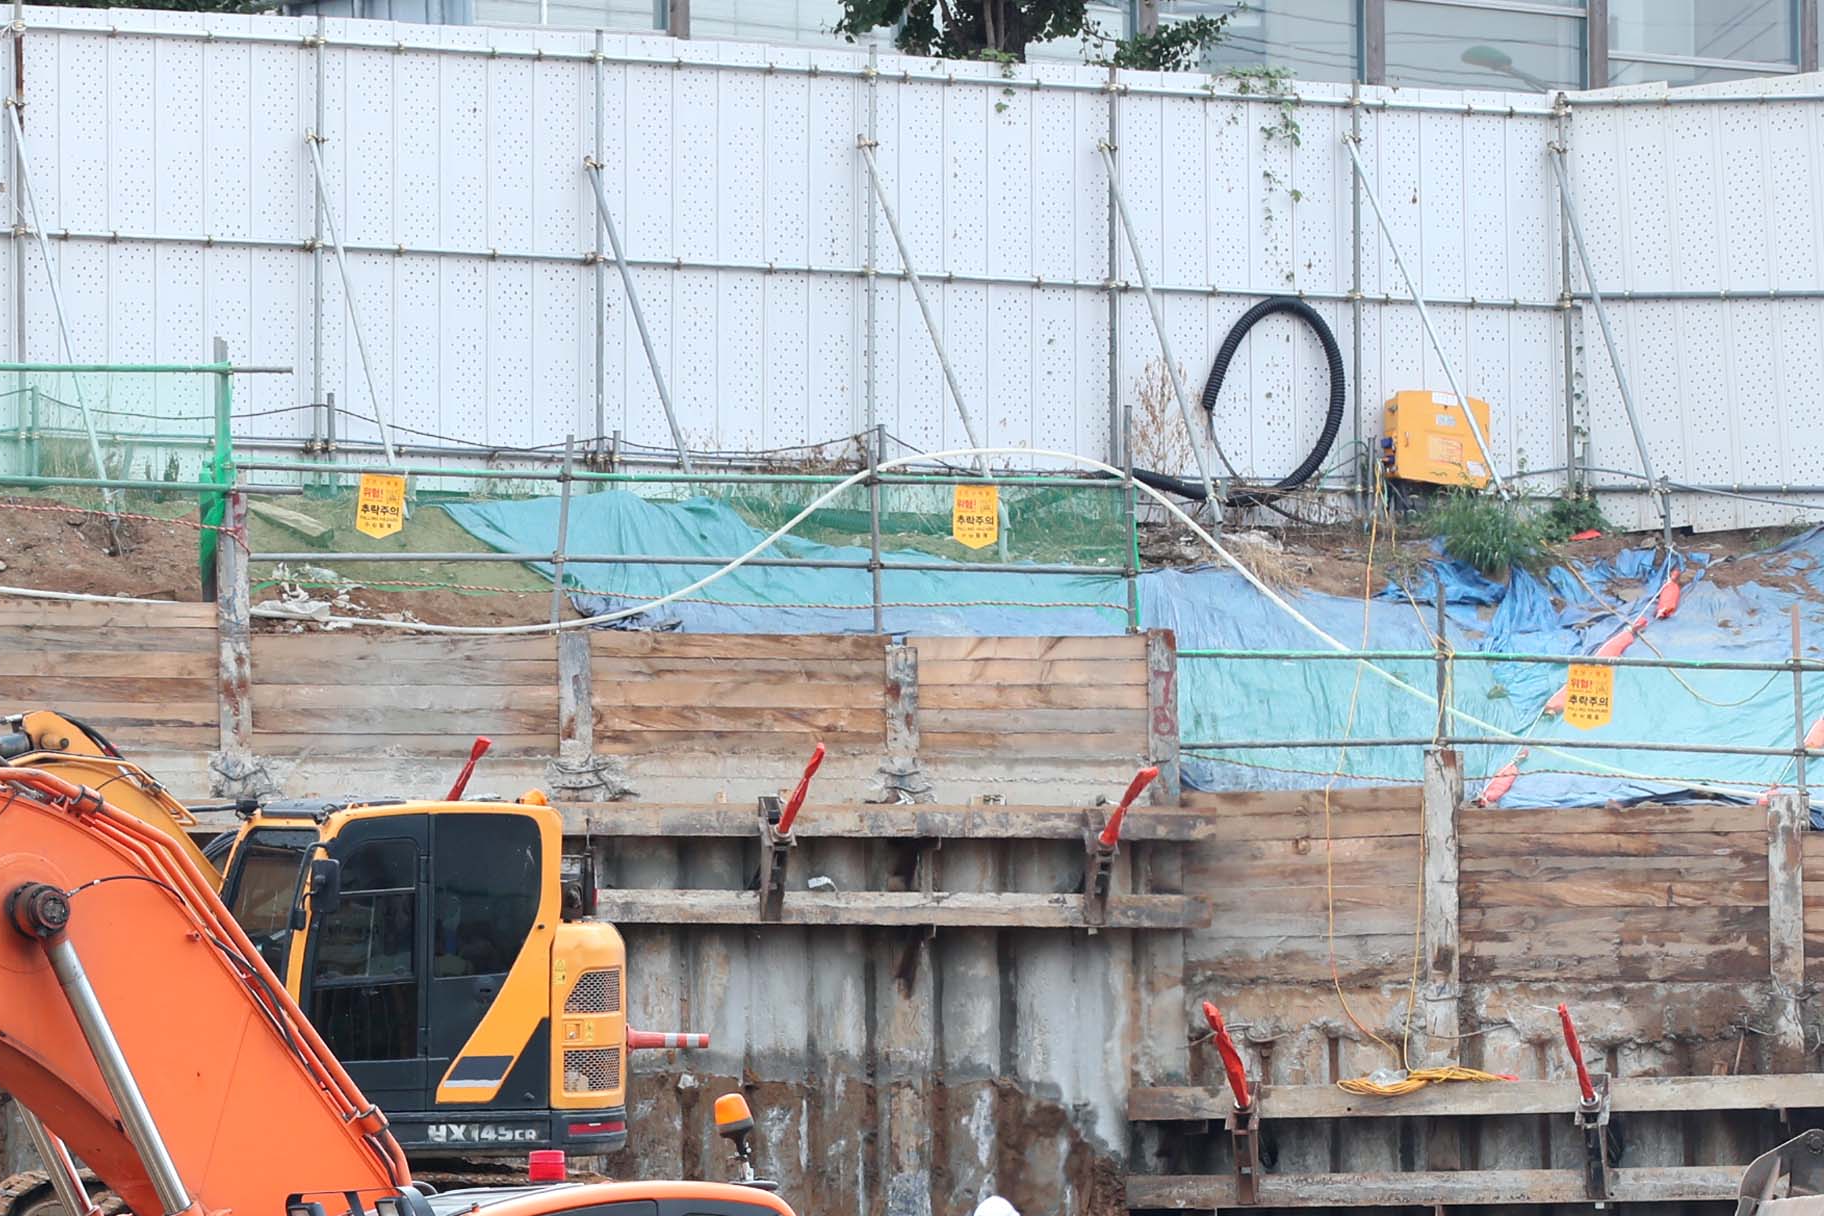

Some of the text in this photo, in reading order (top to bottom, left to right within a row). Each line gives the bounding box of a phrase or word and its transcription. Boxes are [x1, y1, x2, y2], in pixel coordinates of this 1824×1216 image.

[361, 504, 399, 516] 추락주의
[957, 515, 994, 525] 추락주의
[1568, 694, 1608, 707] 추락주의
